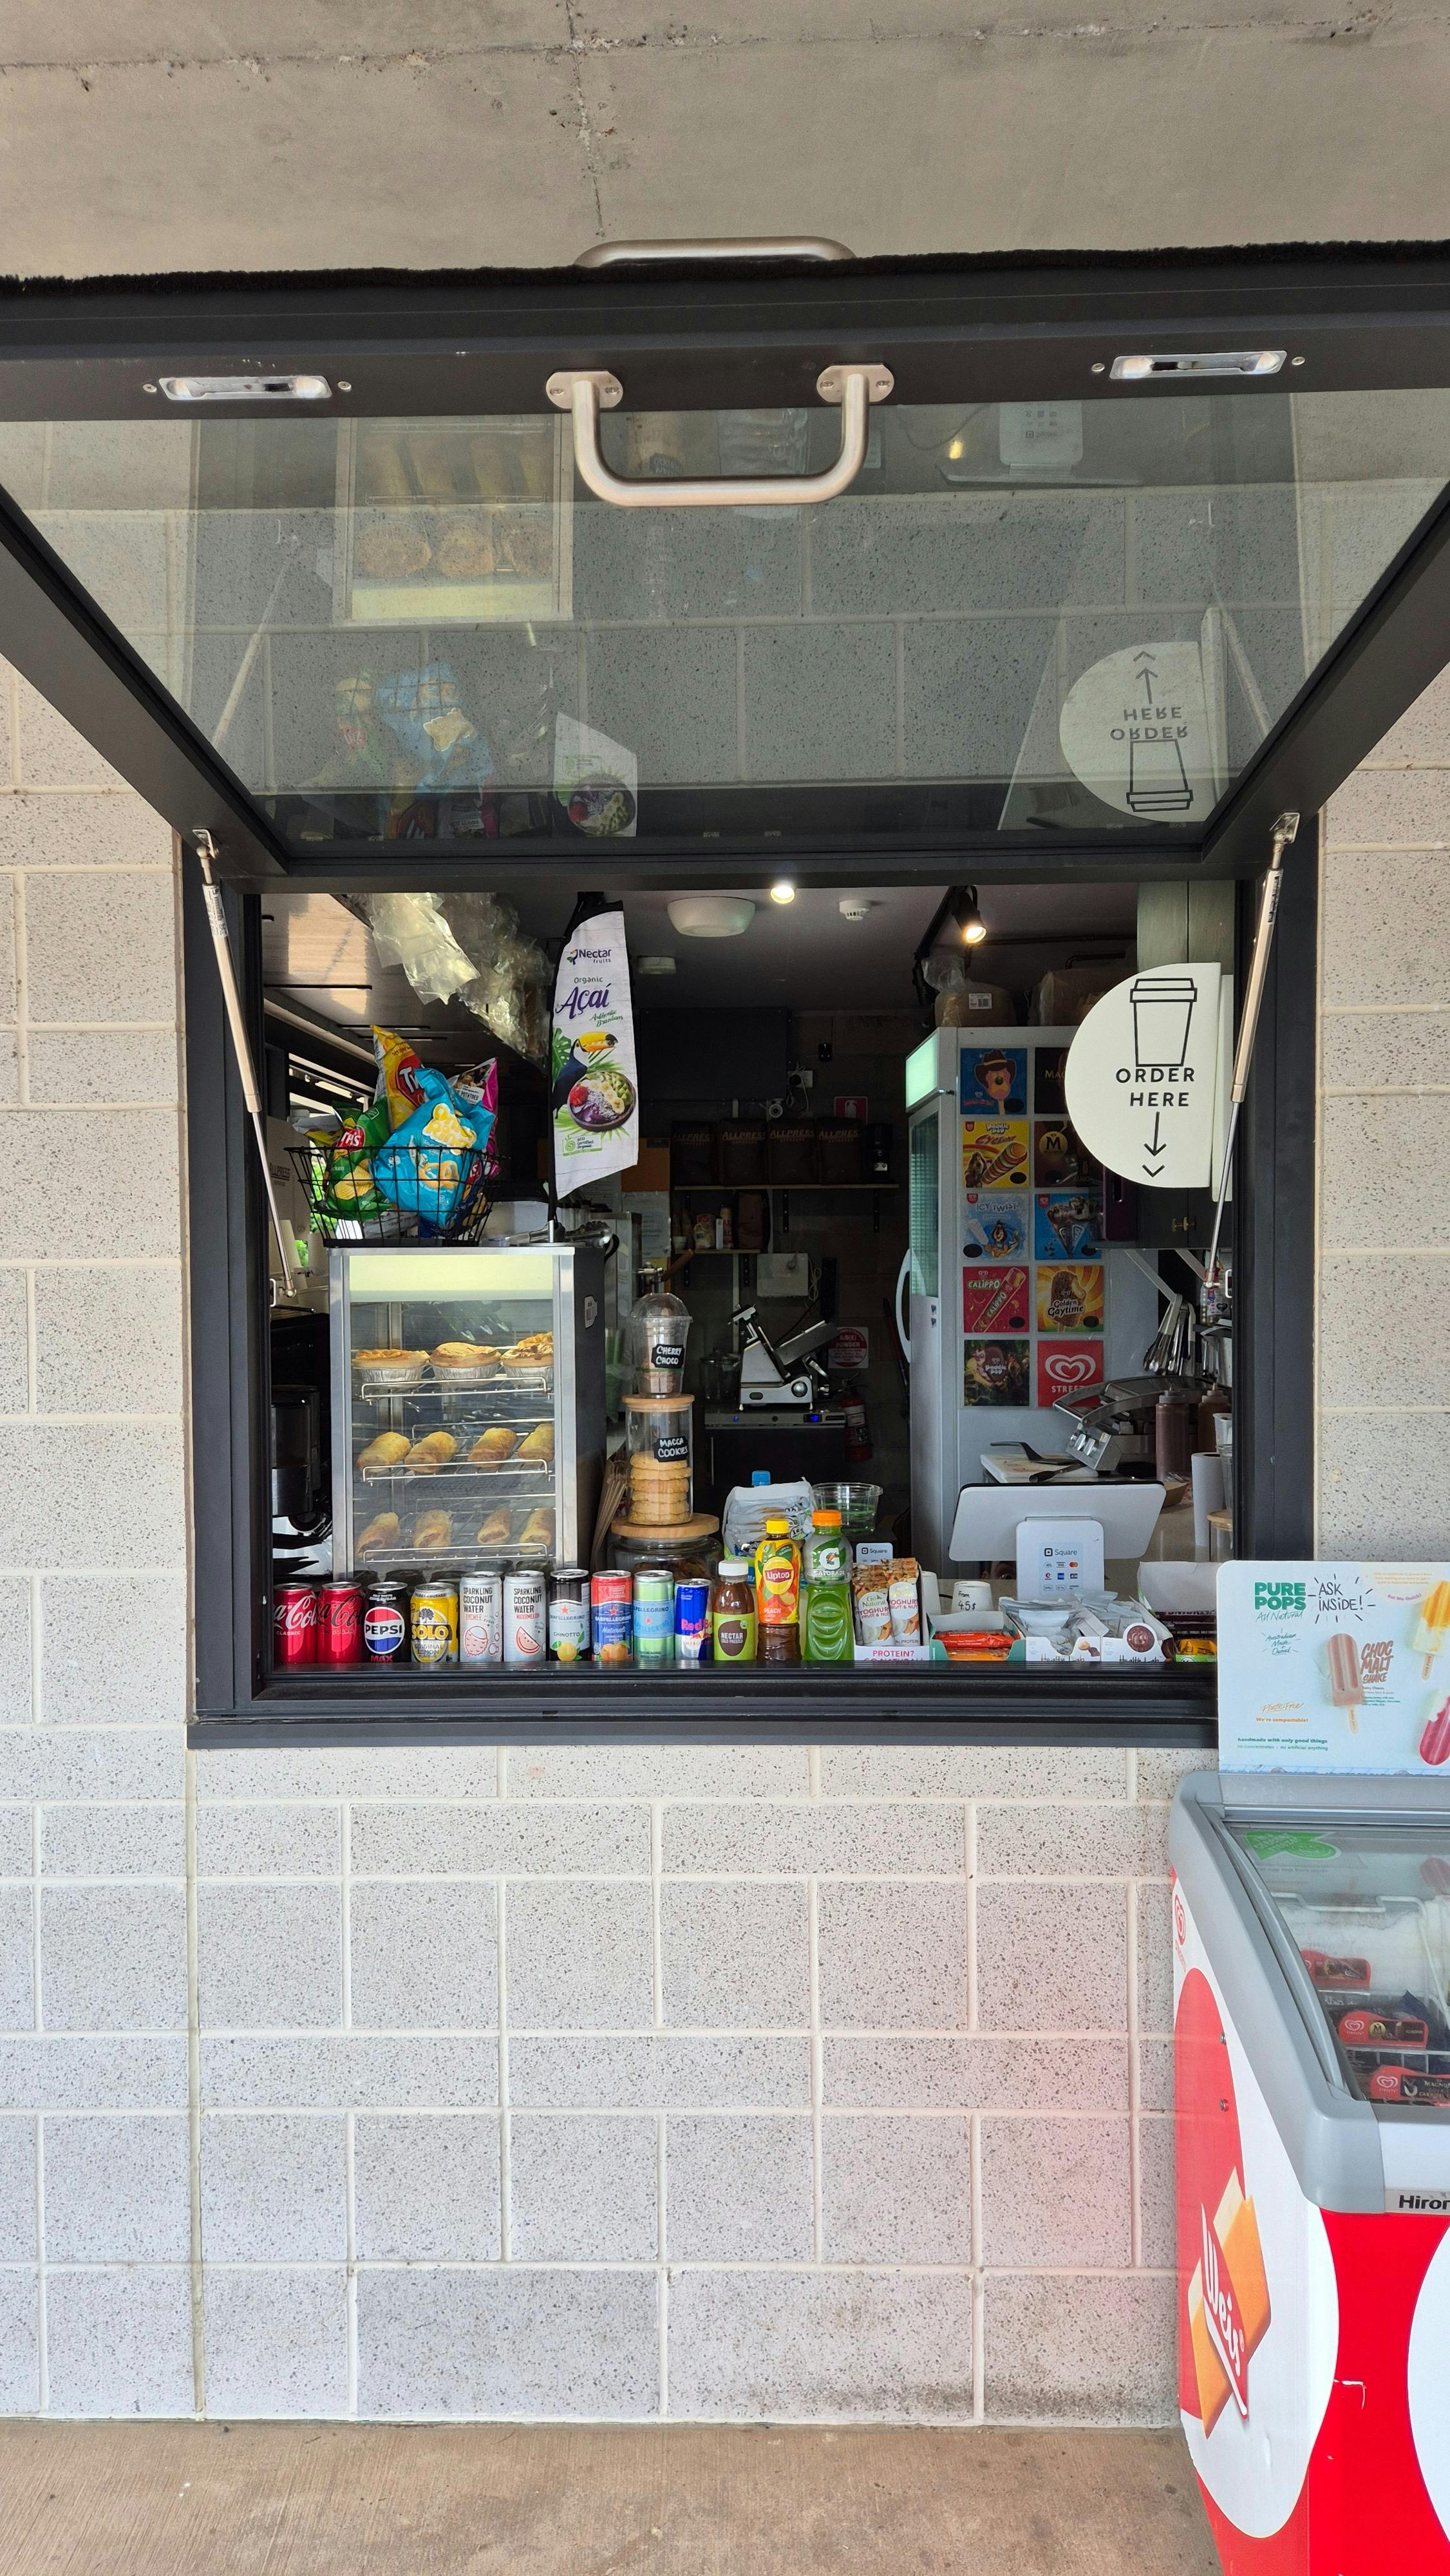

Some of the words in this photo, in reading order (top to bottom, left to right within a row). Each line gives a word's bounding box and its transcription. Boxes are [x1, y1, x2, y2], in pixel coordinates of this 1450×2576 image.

[579, 949, 612, 958] Nectar
[555, 983, 612, 1019] Açaí
[1116, 1068, 1195, 1083] ORDER
[460, 1091, 479, 1101] POTATOES
[1130, 1092, 1190, 1107] HERE
[992, 1202, 1018, 1213] TWIST
[1053, 1299, 1077, 1308] Golden
[1048, 1306, 1084, 1316] Gaytime
[657, 1346, 682, 1356] CHERRY
[656, 1356, 679, 1365] CHOCO
[660, 1437, 683, 1447] MACCA
[658, 1446, 688, 1457] COOKIES
[767, 1572, 790, 1581] Lipton
[514, 1586, 541, 1595] SPARKLING
[1255, 1582, 1306, 1596] PURE
[1319, 1582, 1343, 1596] ASK
[464, 1595, 493, 1604] COCONUT
[514, 1594, 542, 1604] COCONUT
[862, 1599, 887, 1608] Natural
[1255, 1596, 1306, 1611] POPS
[464, 1604, 484, 1613] WATER
[514, 1605, 534, 1613] WATER
[1270, 1610, 1304, 1620] Natural
[366, 1624, 402, 1634] PEPSI
[681, 1618, 702, 1631] Red
[704, 1618, 712, 1629] Bu
[412, 1625, 449, 1640] SOLO
[1361, 1640, 1394, 1660] CHOC
[1360, 1655, 1394, 1674] MALT
[1362, 1672, 1388, 1683] SHAKE
[1424, 2080, 1450, 2089] MAGNU
